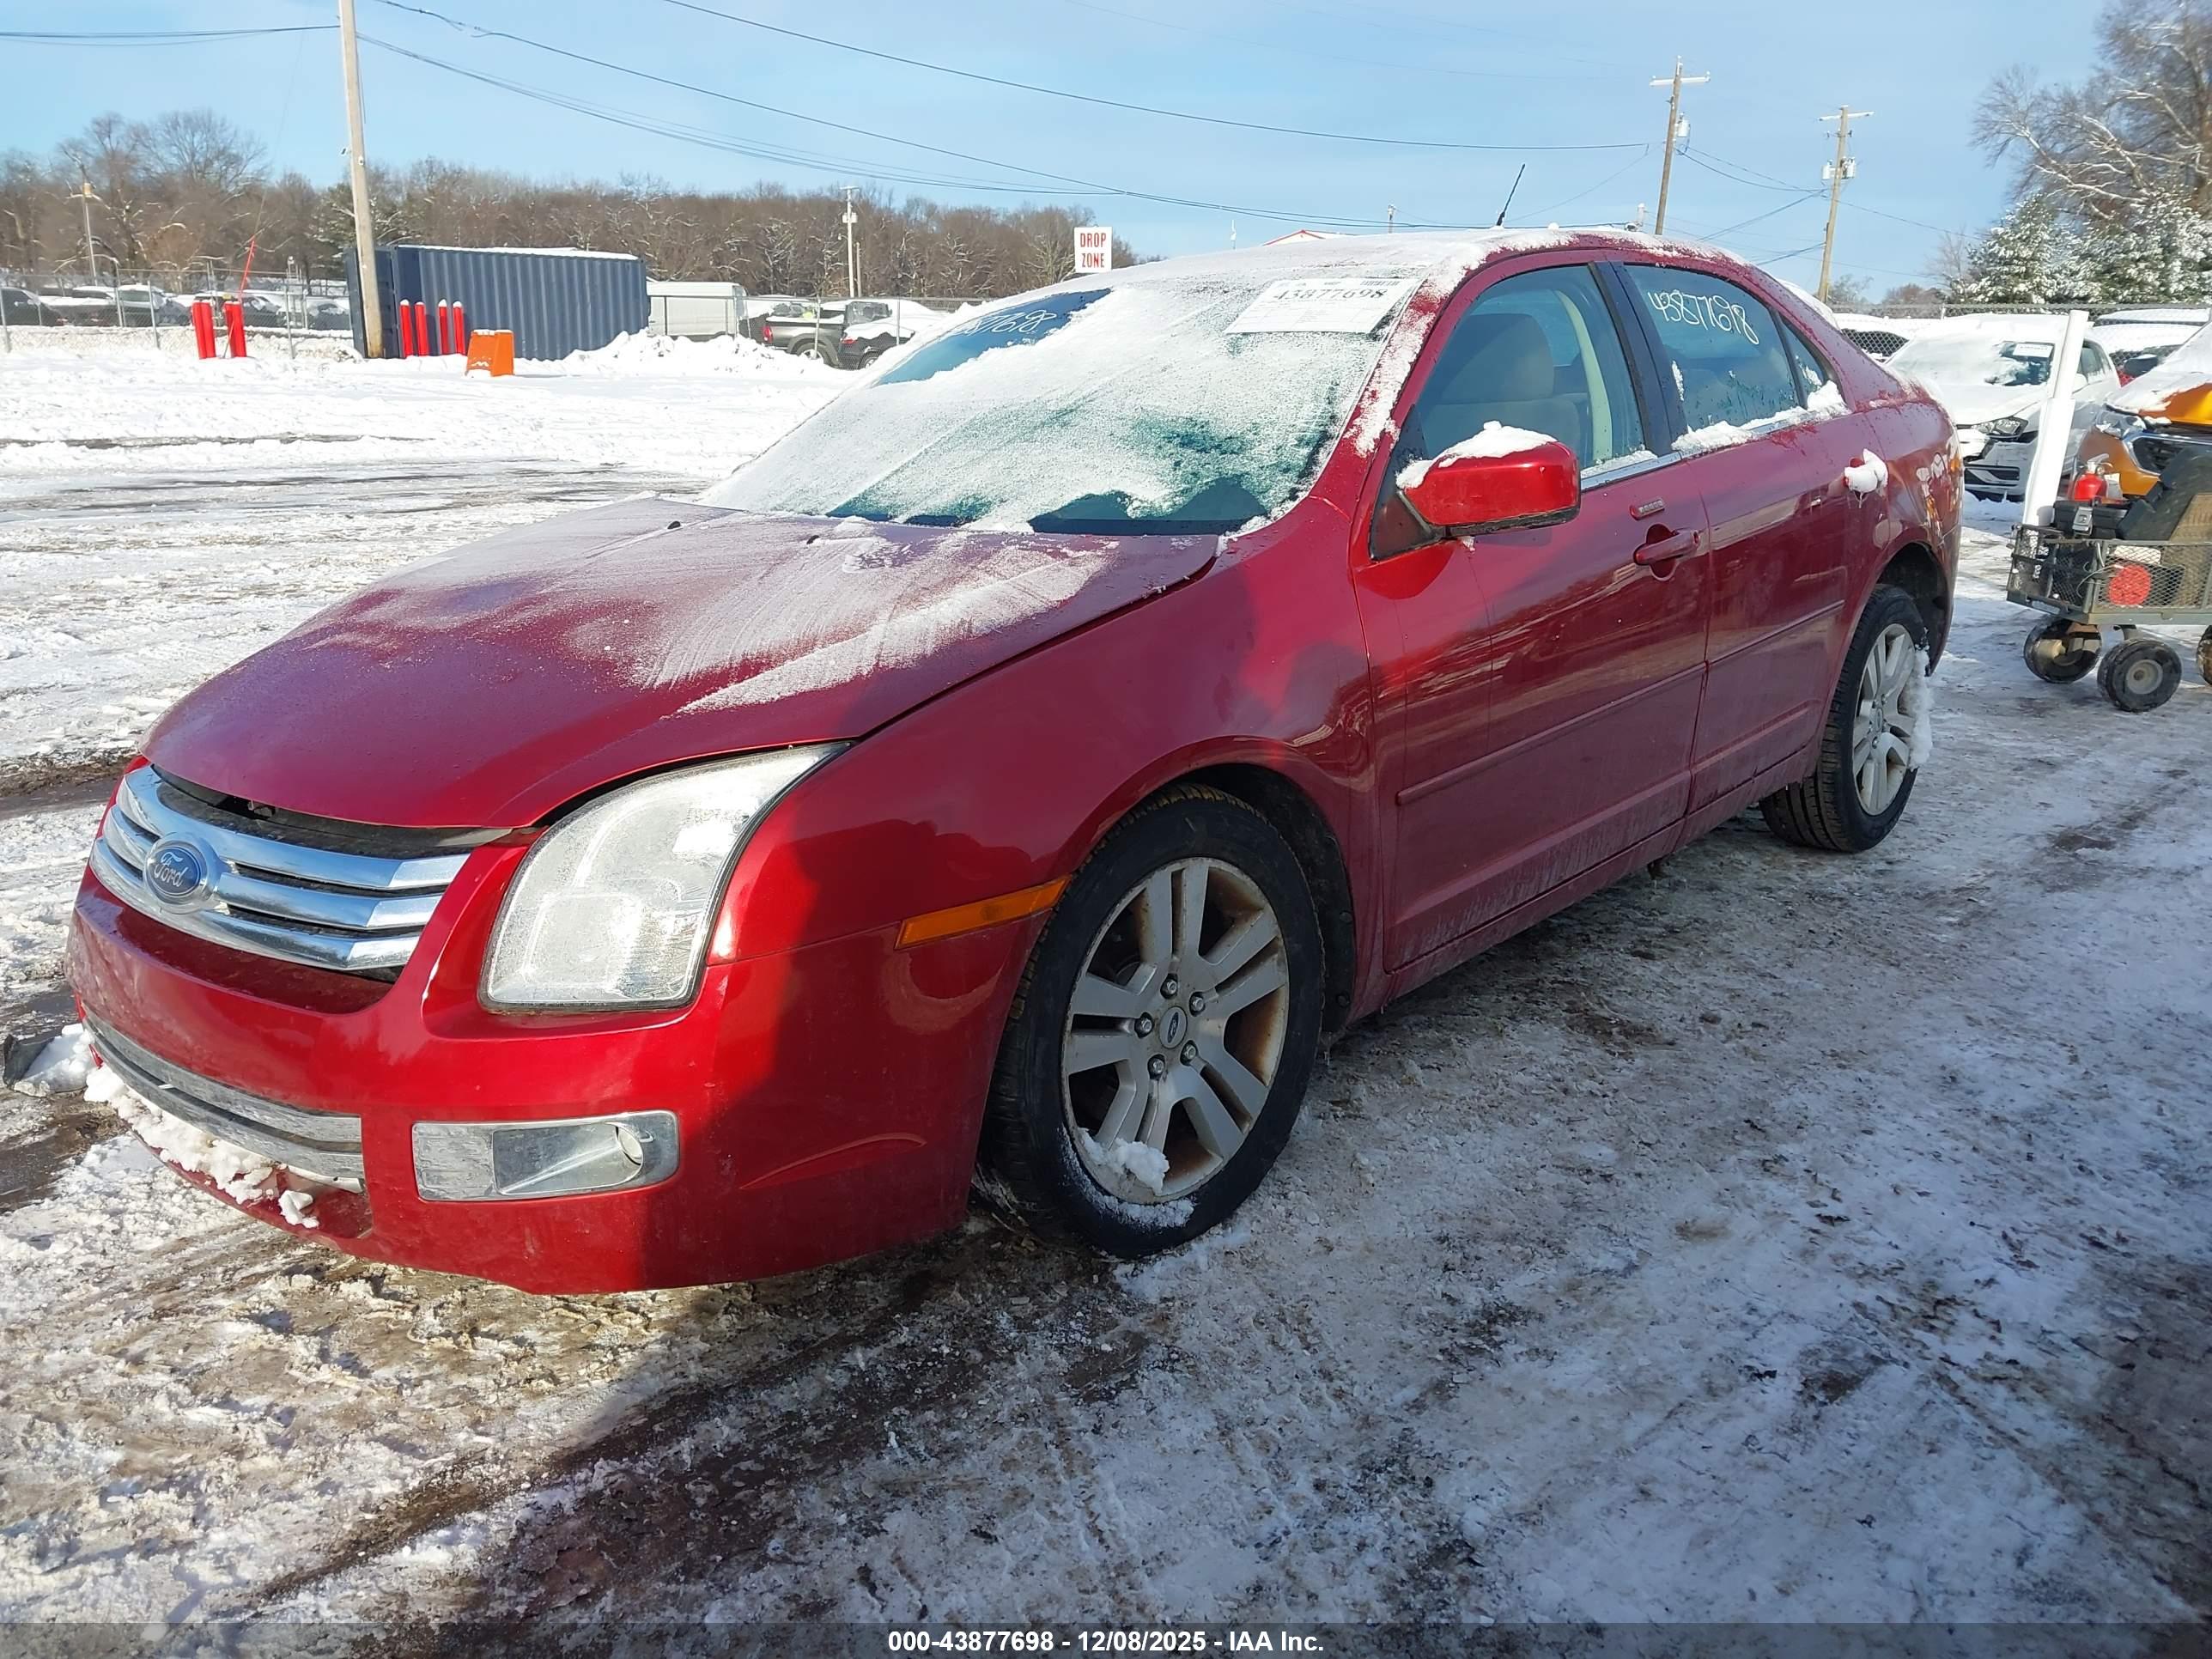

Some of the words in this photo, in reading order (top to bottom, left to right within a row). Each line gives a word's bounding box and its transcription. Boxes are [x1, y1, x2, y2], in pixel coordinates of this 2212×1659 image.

[1079, 232, 1107, 248] DROP
[1080, 252, 1106, 269] ZONE
[1646, 289, 1759, 345] 43877698
[153, 850, 189, 888] Ford
